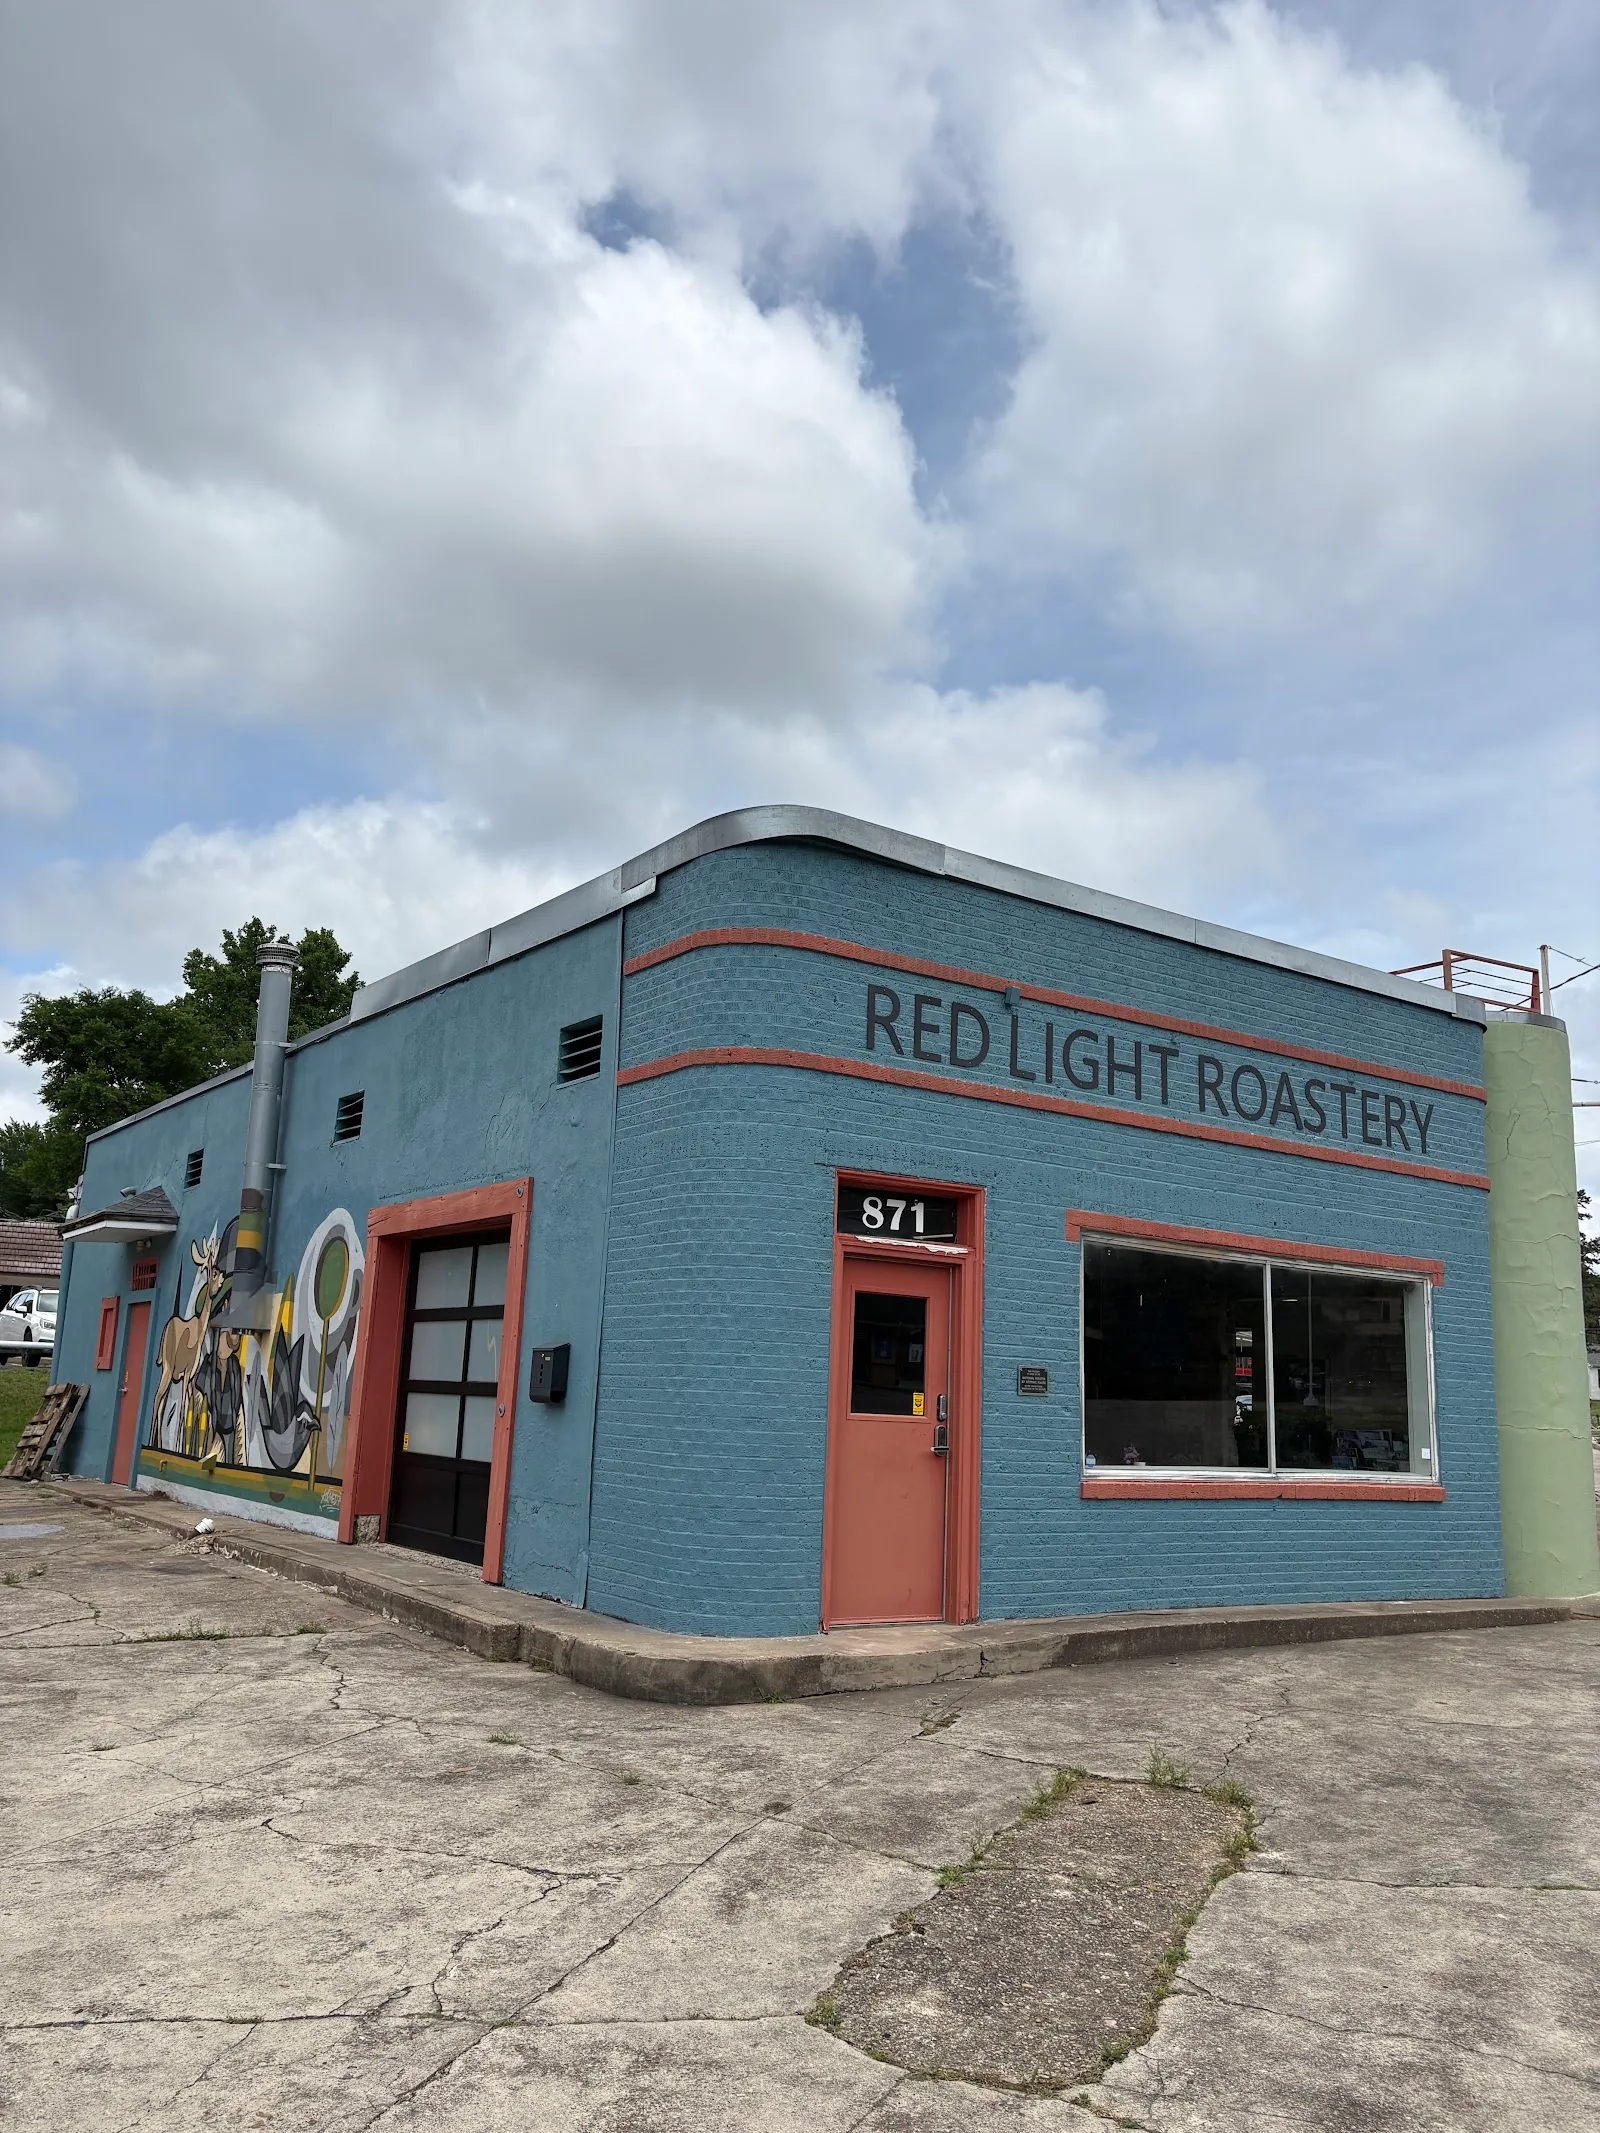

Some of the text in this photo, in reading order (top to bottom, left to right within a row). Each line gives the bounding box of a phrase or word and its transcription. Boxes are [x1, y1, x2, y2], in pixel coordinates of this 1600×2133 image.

[866, 984, 1434, 1154] RED LIGHT ROASTERY
[862, 1196, 925, 1233] 871
